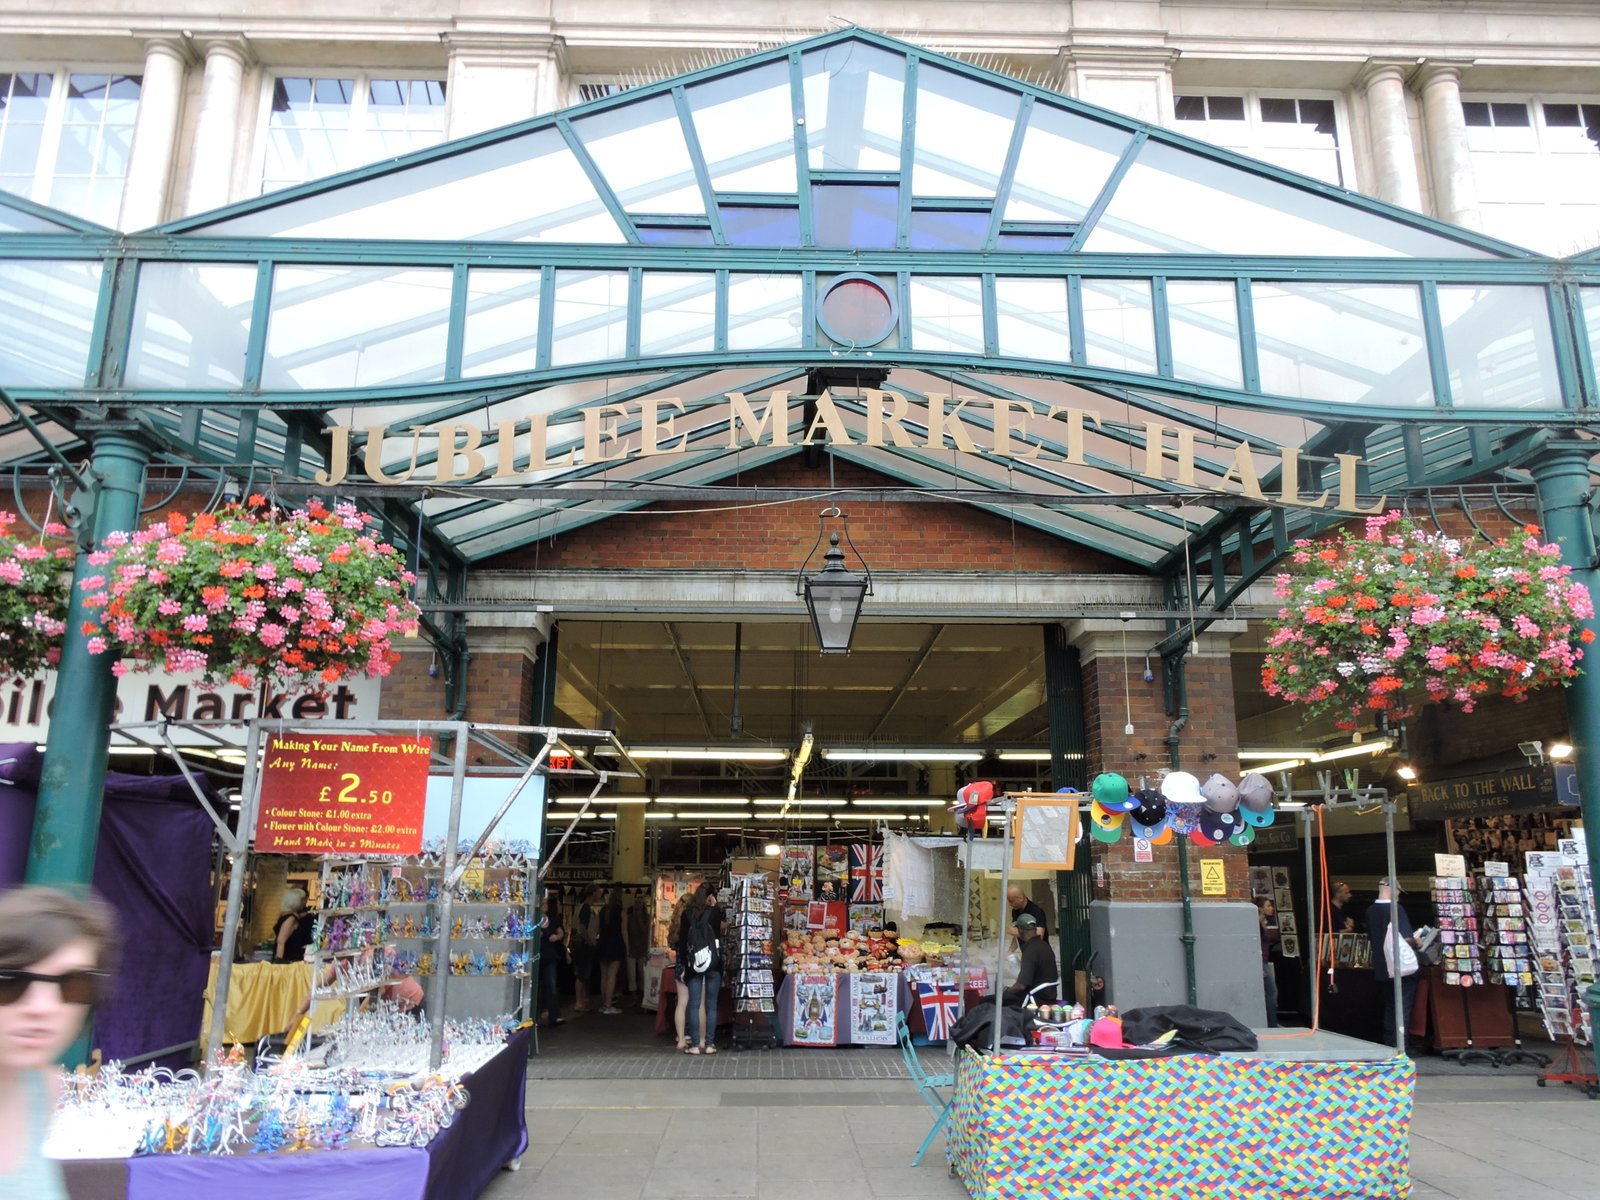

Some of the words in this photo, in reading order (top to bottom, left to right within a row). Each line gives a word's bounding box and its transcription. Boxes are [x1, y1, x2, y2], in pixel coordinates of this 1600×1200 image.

[314, 397, 688, 487] JUBILEE
[724, 388, 1102, 466] MARKET
[1139, 420, 1387, 514] HALL
[145, 680, 358, 729] Market
[272, 739, 310, 753] Making
[312, 739, 337, 752] Your
[340, 741, 370, 752] Name
[372, 742, 398, 754] From
[401, 743, 430, 755] Wire
[268, 756, 296, 772] Any
[301, 757, 339, 770] Name:
[1420, 784, 1449, 802] BACK
[1454, 783, 1470, 798] TO
[1472, 780, 1496, 795] THE
[1501, 774, 1536, 792] WALL
[1444, 800, 1478, 811] FAMOUS
[1481, 796, 1509, 807] FACES
[271, 807, 297, 817] Colour
[298, 808, 323, 818] Stone:
[325, 809, 349, 819] £1.00
[351, 812, 372, 820] extra
[269, 821, 296, 830] Flower
[297, 821, 314, 831] with
[315, 822, 342, 832] Colour
[343, 823, 368, 833] Stone:
[370, 824, 395, 834] £2.00
[396, 827, 417, 835] extra
[273, 836, 301, 847] Hand
[305, 836, 332, 847] Made
[359, 838, 401, 850] Minutes
